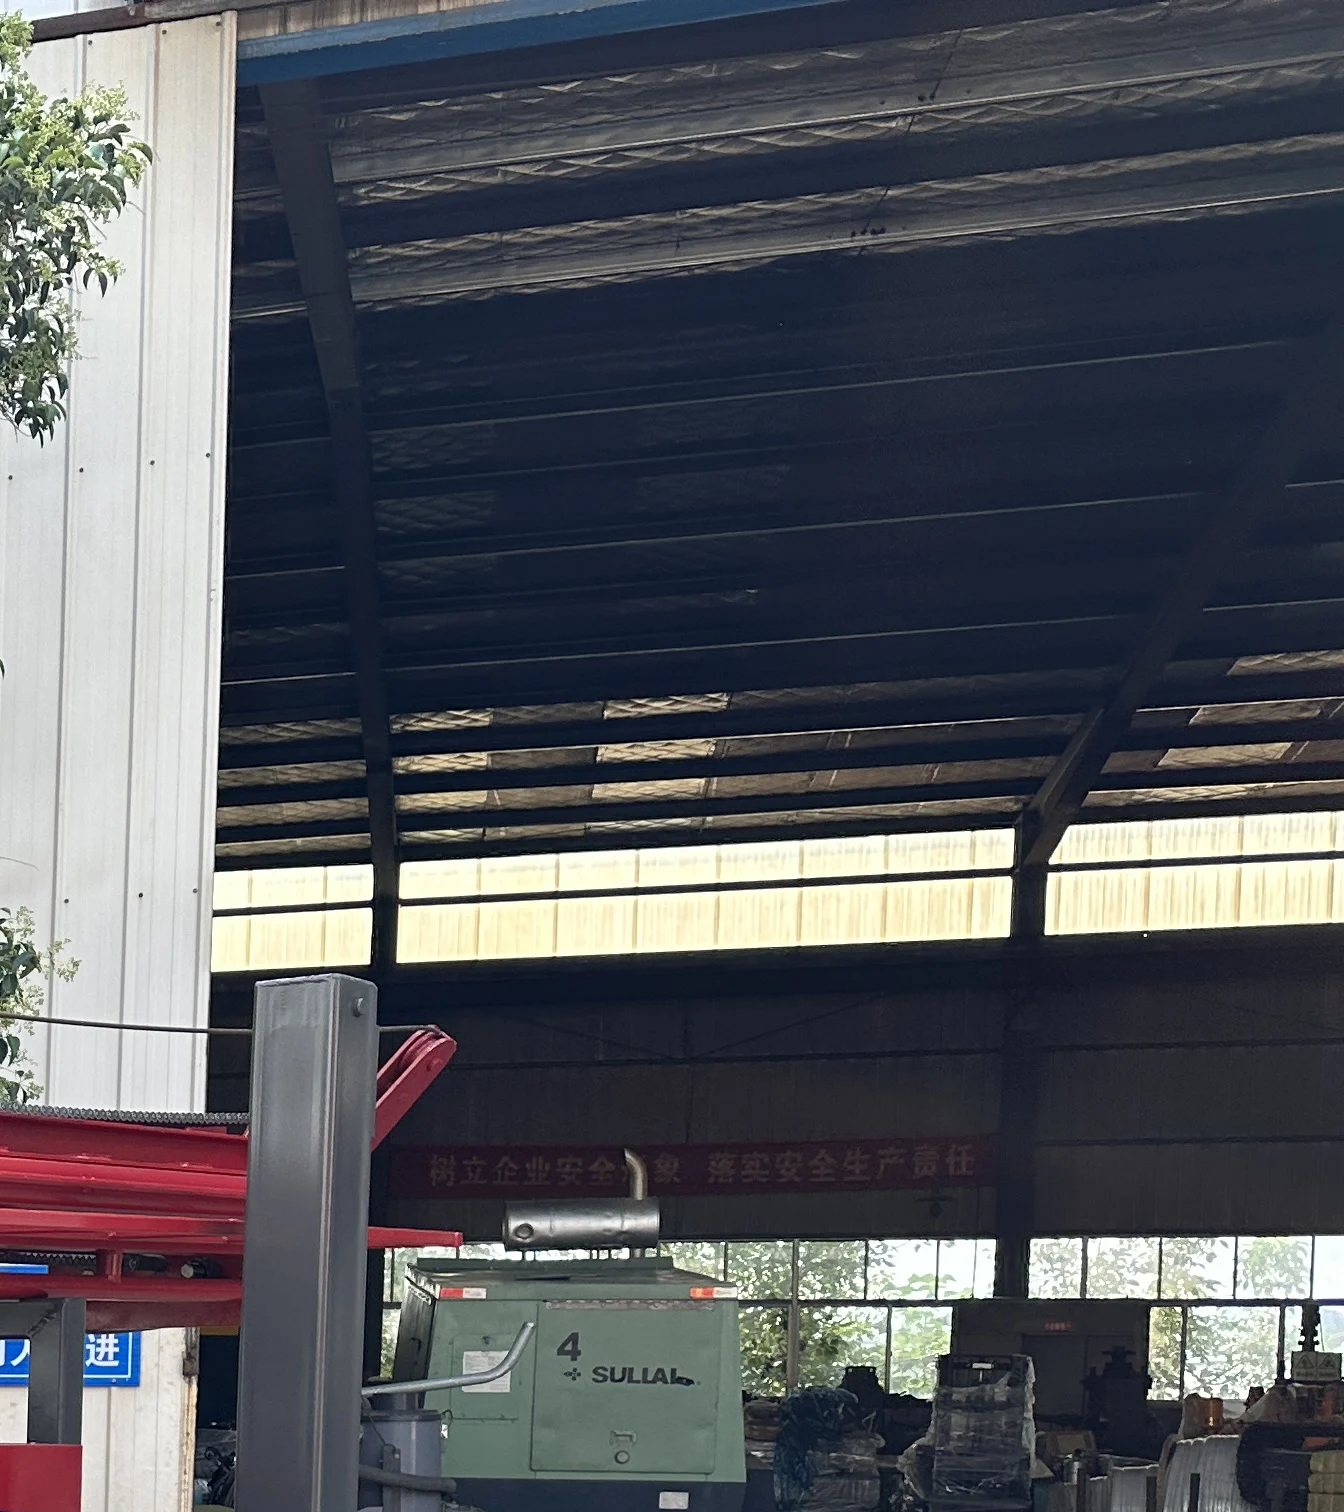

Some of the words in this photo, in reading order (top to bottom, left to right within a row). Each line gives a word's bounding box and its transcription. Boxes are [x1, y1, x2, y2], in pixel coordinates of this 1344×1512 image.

[428, 1153, 682, 1188] 树立企业安全象
[707, 1143, 975, 1184] 落实安全生产责任
[556, 1331, 582, 1362] 4
[591, 1365, 696, 1387] SULLAI
